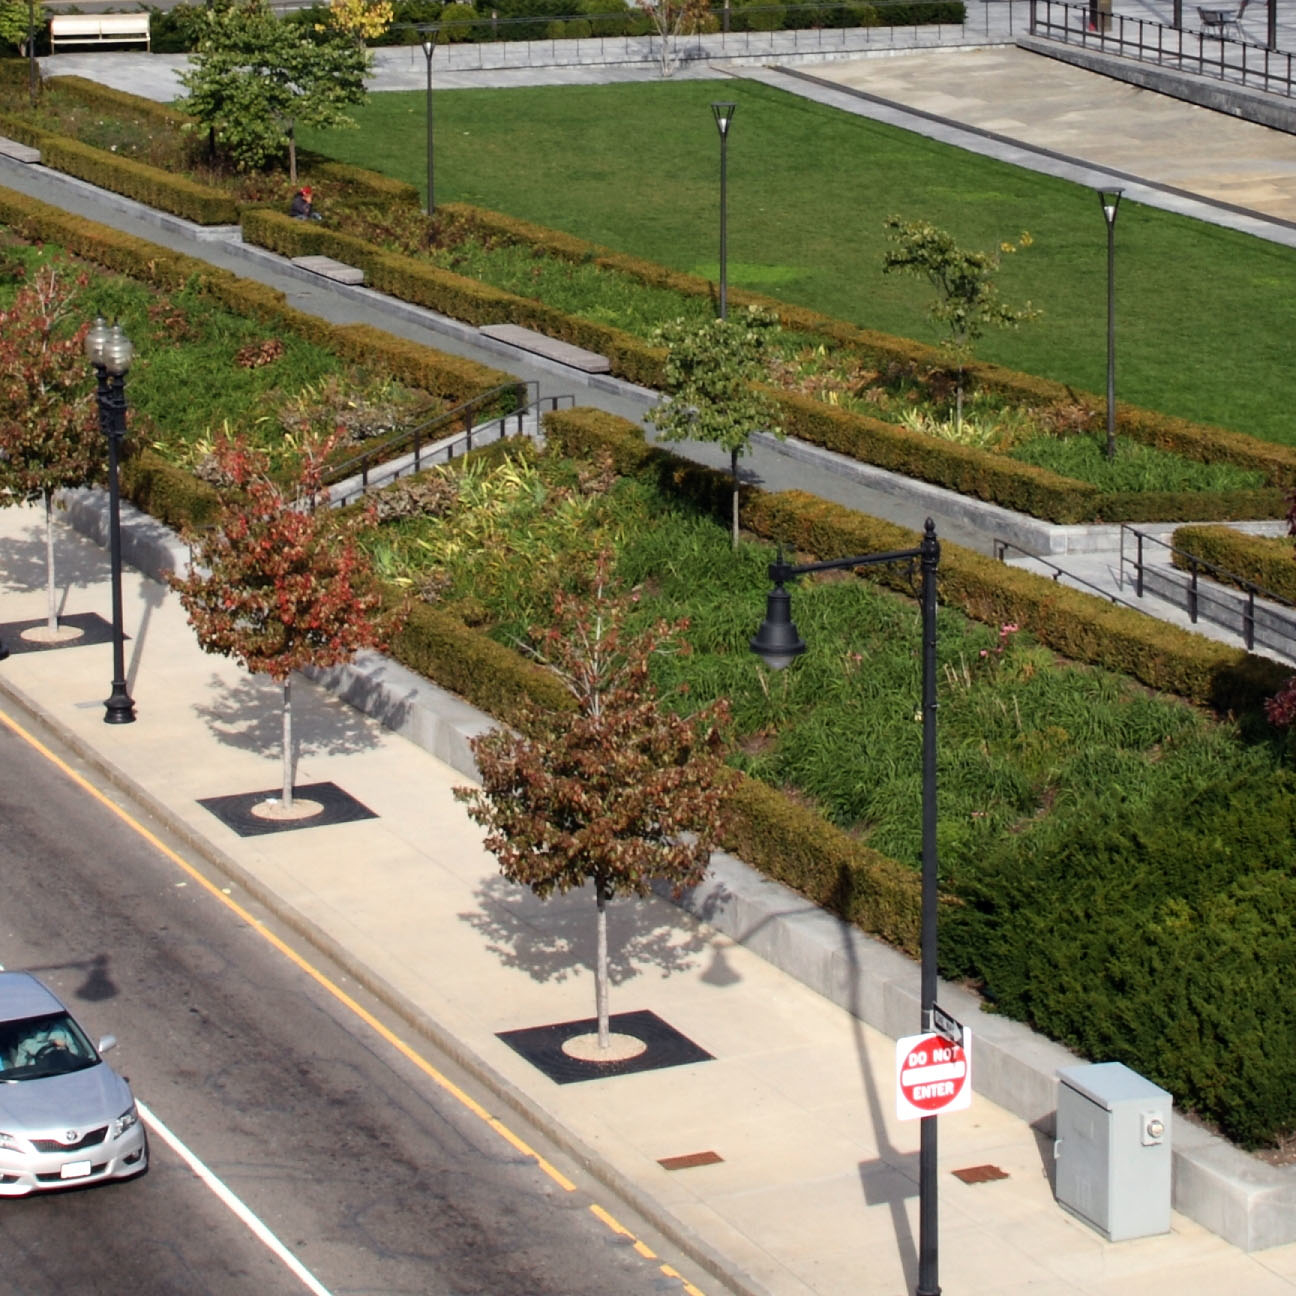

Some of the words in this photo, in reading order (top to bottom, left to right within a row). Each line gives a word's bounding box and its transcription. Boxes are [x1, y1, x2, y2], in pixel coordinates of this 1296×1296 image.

[908, 1051, 928, 1068] DO
[932, 1045, 960, 1063] NOT
[912, 1081, 955, 1101] ENTER
